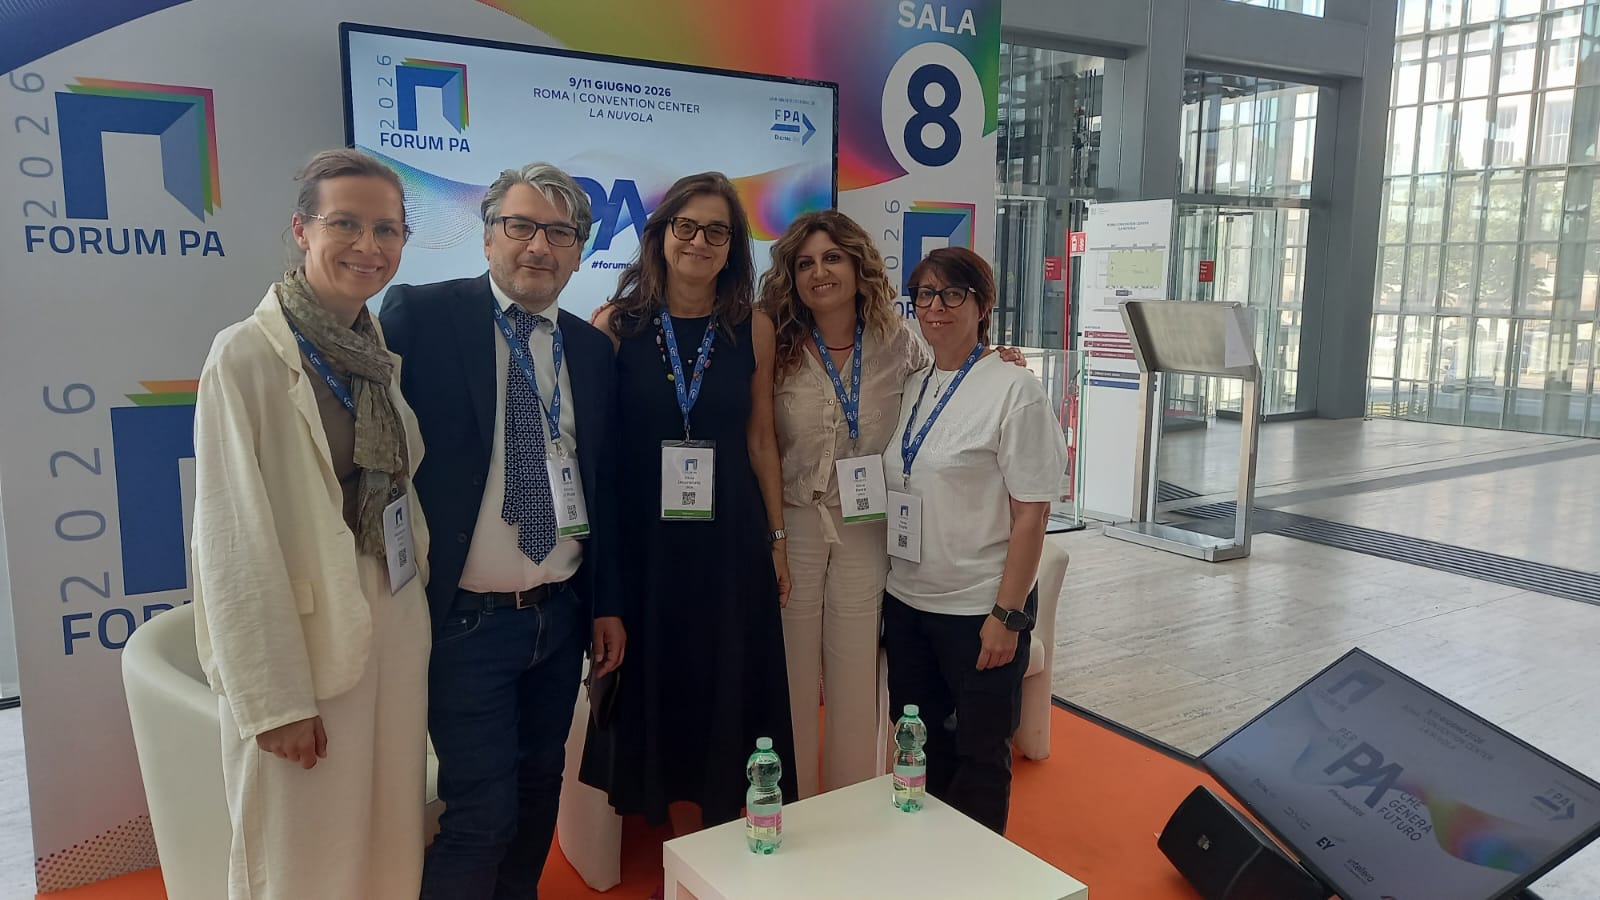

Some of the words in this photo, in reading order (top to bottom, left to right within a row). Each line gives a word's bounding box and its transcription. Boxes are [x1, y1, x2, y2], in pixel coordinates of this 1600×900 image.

[897, 0, 977, 36] SALA
[377, 54, 395, 129] 2026
[533, 87, 569, 101] ROMA
[579, 92, 655, 109] CONVENTION
[657, 101, 700, 114] CENTER
[569, 77, 592, 91] 9/11
[594, 80, 641, 94] GIUGNO
[644, 86, 671, 97] 2026
[589, 108, 604, 118] LA
[607, 110, 653, 123] NUVOLA
[774, 108, 800, 123] FPA
[903, 63, 962, 167] 8
[9, 71, 58, 219] 2026
[380, 132, 443, 151] FORUM
[449, 137, 471, 152] PA
[24, 224, 167, 256] FORUM
[179, 229, 226, 257] PA
[43, 383, 111, 603] 2026
[1323, 741, 1404, 808] PA
[1388, 799, 1433, 834] GENERA
[1400, 792, 1425, 810] CHE
[1377, 806, 1422, 841] FUTURO
[1315, 836, 1336, 850] EY
